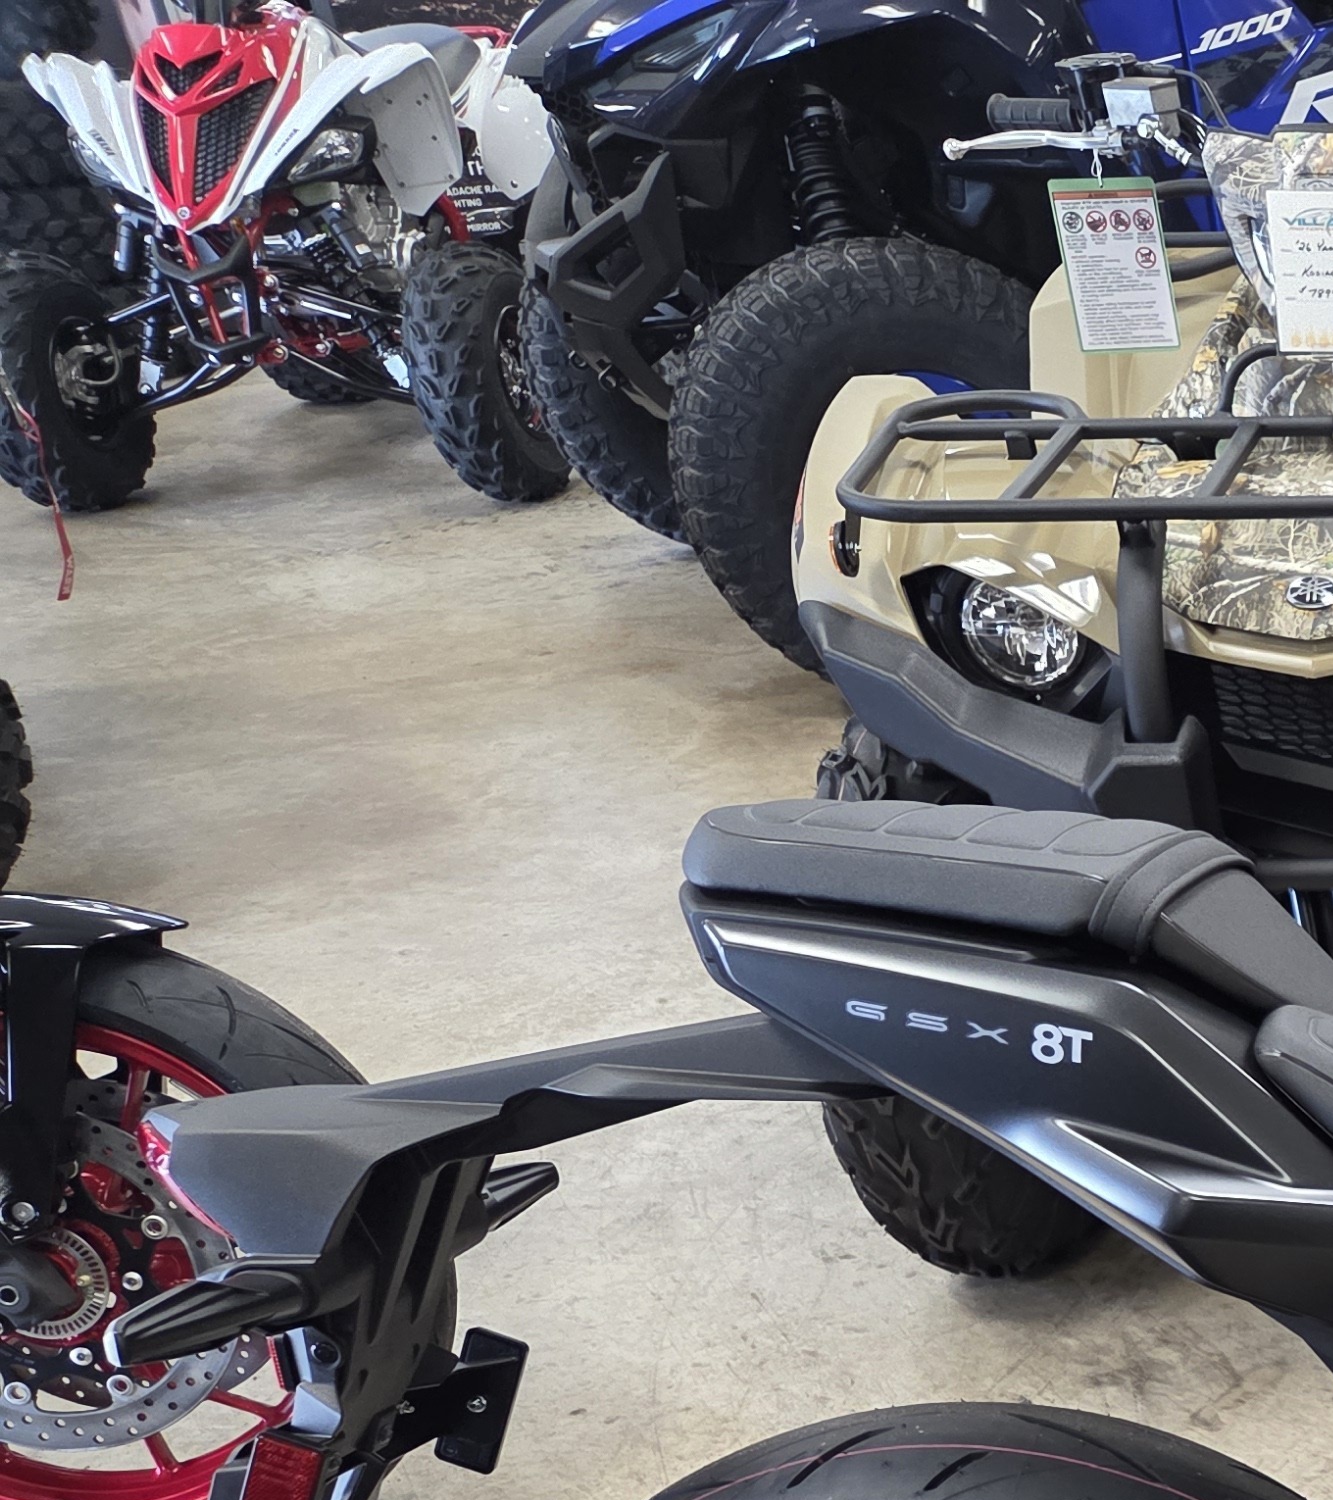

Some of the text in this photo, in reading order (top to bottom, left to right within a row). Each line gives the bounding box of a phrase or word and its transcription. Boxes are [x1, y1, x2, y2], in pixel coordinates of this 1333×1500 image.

[1190, 7, 1293, 54] 1000
[446, 185, 484, 196] ADACHE
[845, 1000, 1093, 1065] GSX 8T
